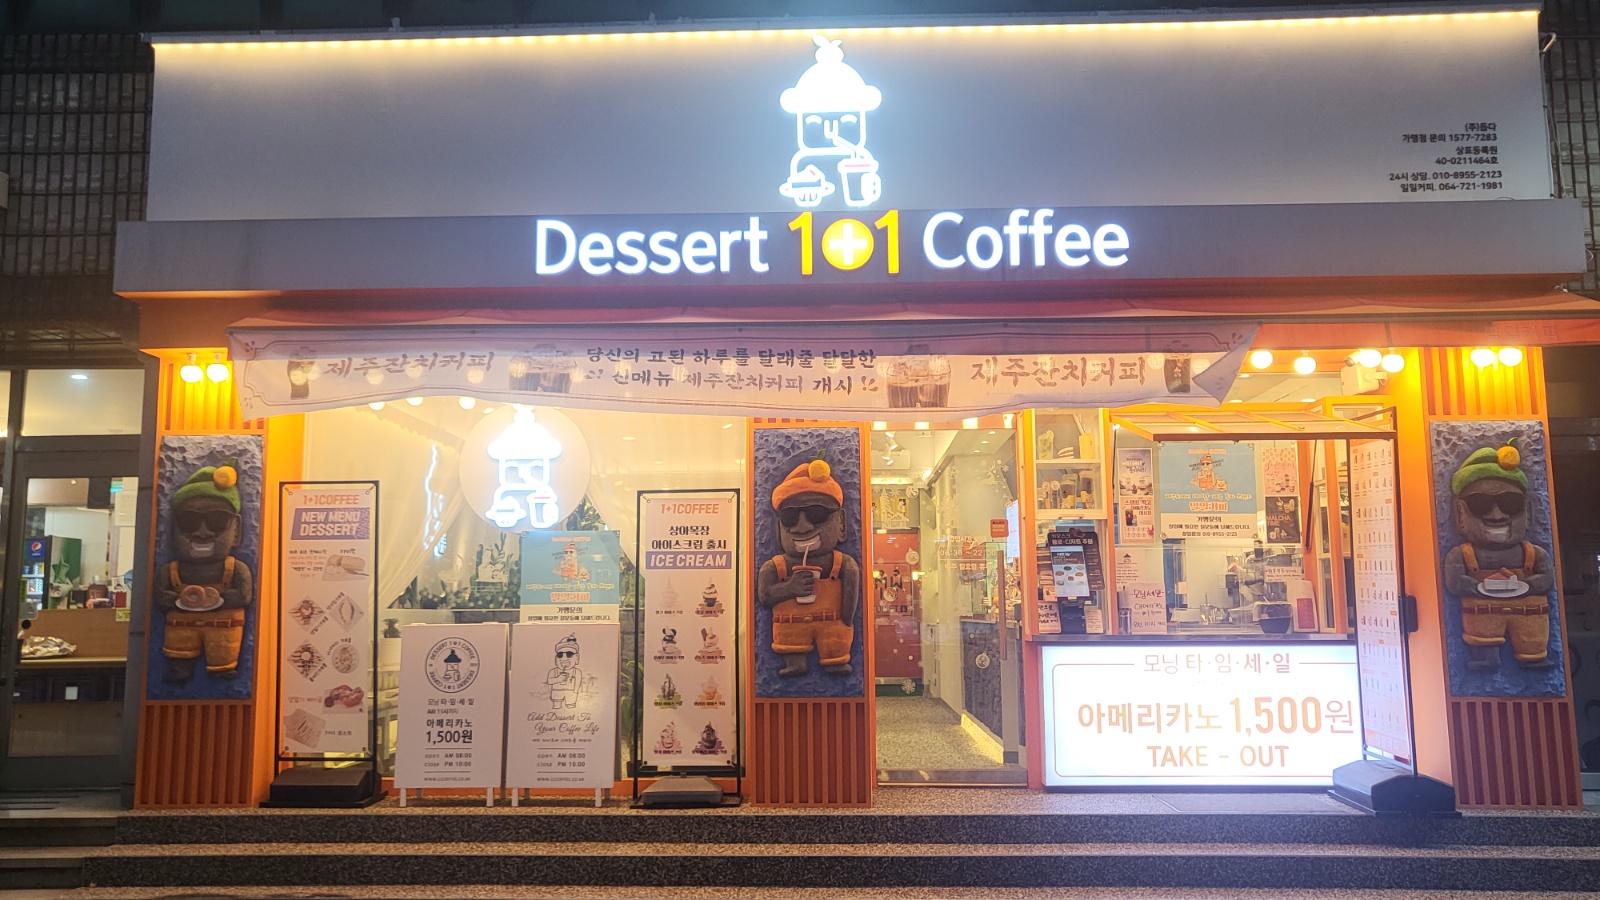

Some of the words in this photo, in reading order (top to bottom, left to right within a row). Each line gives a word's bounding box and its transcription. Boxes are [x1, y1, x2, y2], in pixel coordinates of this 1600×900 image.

[1402, 133, 1427, 143] 가맹점
[1429, 133, 1446, 142] 문의
[1449, 133, 1497, 141] 1577-7283
[1435, 156, 1499, 164] 40-0211464호
[1389, 172, 1409, 181] 24시
[1432, 170, 1502, 179] 010-8955-2123
[1439, 181, 1502, 191] 064-721-1981
[535, 216, 770, 276] Dessert
[922, 208, 1130, 269] Coffee
[322, 351, 495, 378] 제주잔치커피
[586, 347, 640, 364] 당신의
[646, 348, 685, 365] 고된
[692, 347, 751, 366] 하루를
[758, 348, 815, 368] 달래줄
[822, 348, 877, 369] 달달한
[971, 356, 1146, 388] 제주잔치커피
[613, 369, 675, 387] 신메뉴
[681, 370, 804, 393] 제주잔치커피
[812, 376, 854, 396] 개시
[303, 494, 360, 506] 1+1COFFEE
[660, 503, 720, 514] 1+1COFFEE
[301, 511, 327, 522] NEW
[328, 511, 361, 522] MENU
[300, 523, 360, 536] DESSERT
[651, 539, 703, 550] 아이스크림
[706, 538, 727, 550] 출시
[650, 554, 674, 567] ICE
[675, 554, 727, 567] CREAM
[1143, 653, 1179, 675] 모닝
[426, 718, 473, 728] 아메리카노
[527, 711, 545, 722] Add
[545, 711, 576, 722] Dessert
[577, 712, 592, 721] To
[1077, 702, 1223, 734] 아메리카노
[1229, 695, 1355, 738] 1,500원
[534, 722, 556, 736] Your
[558, 722, 581, 736] Coffee
[584, 722, 600, 736] Life
[425, 729, 473, 745] 1,500원
[1146, 745, 1209, 767] TAKE
[1239, 745, 1290, 767] OUT
